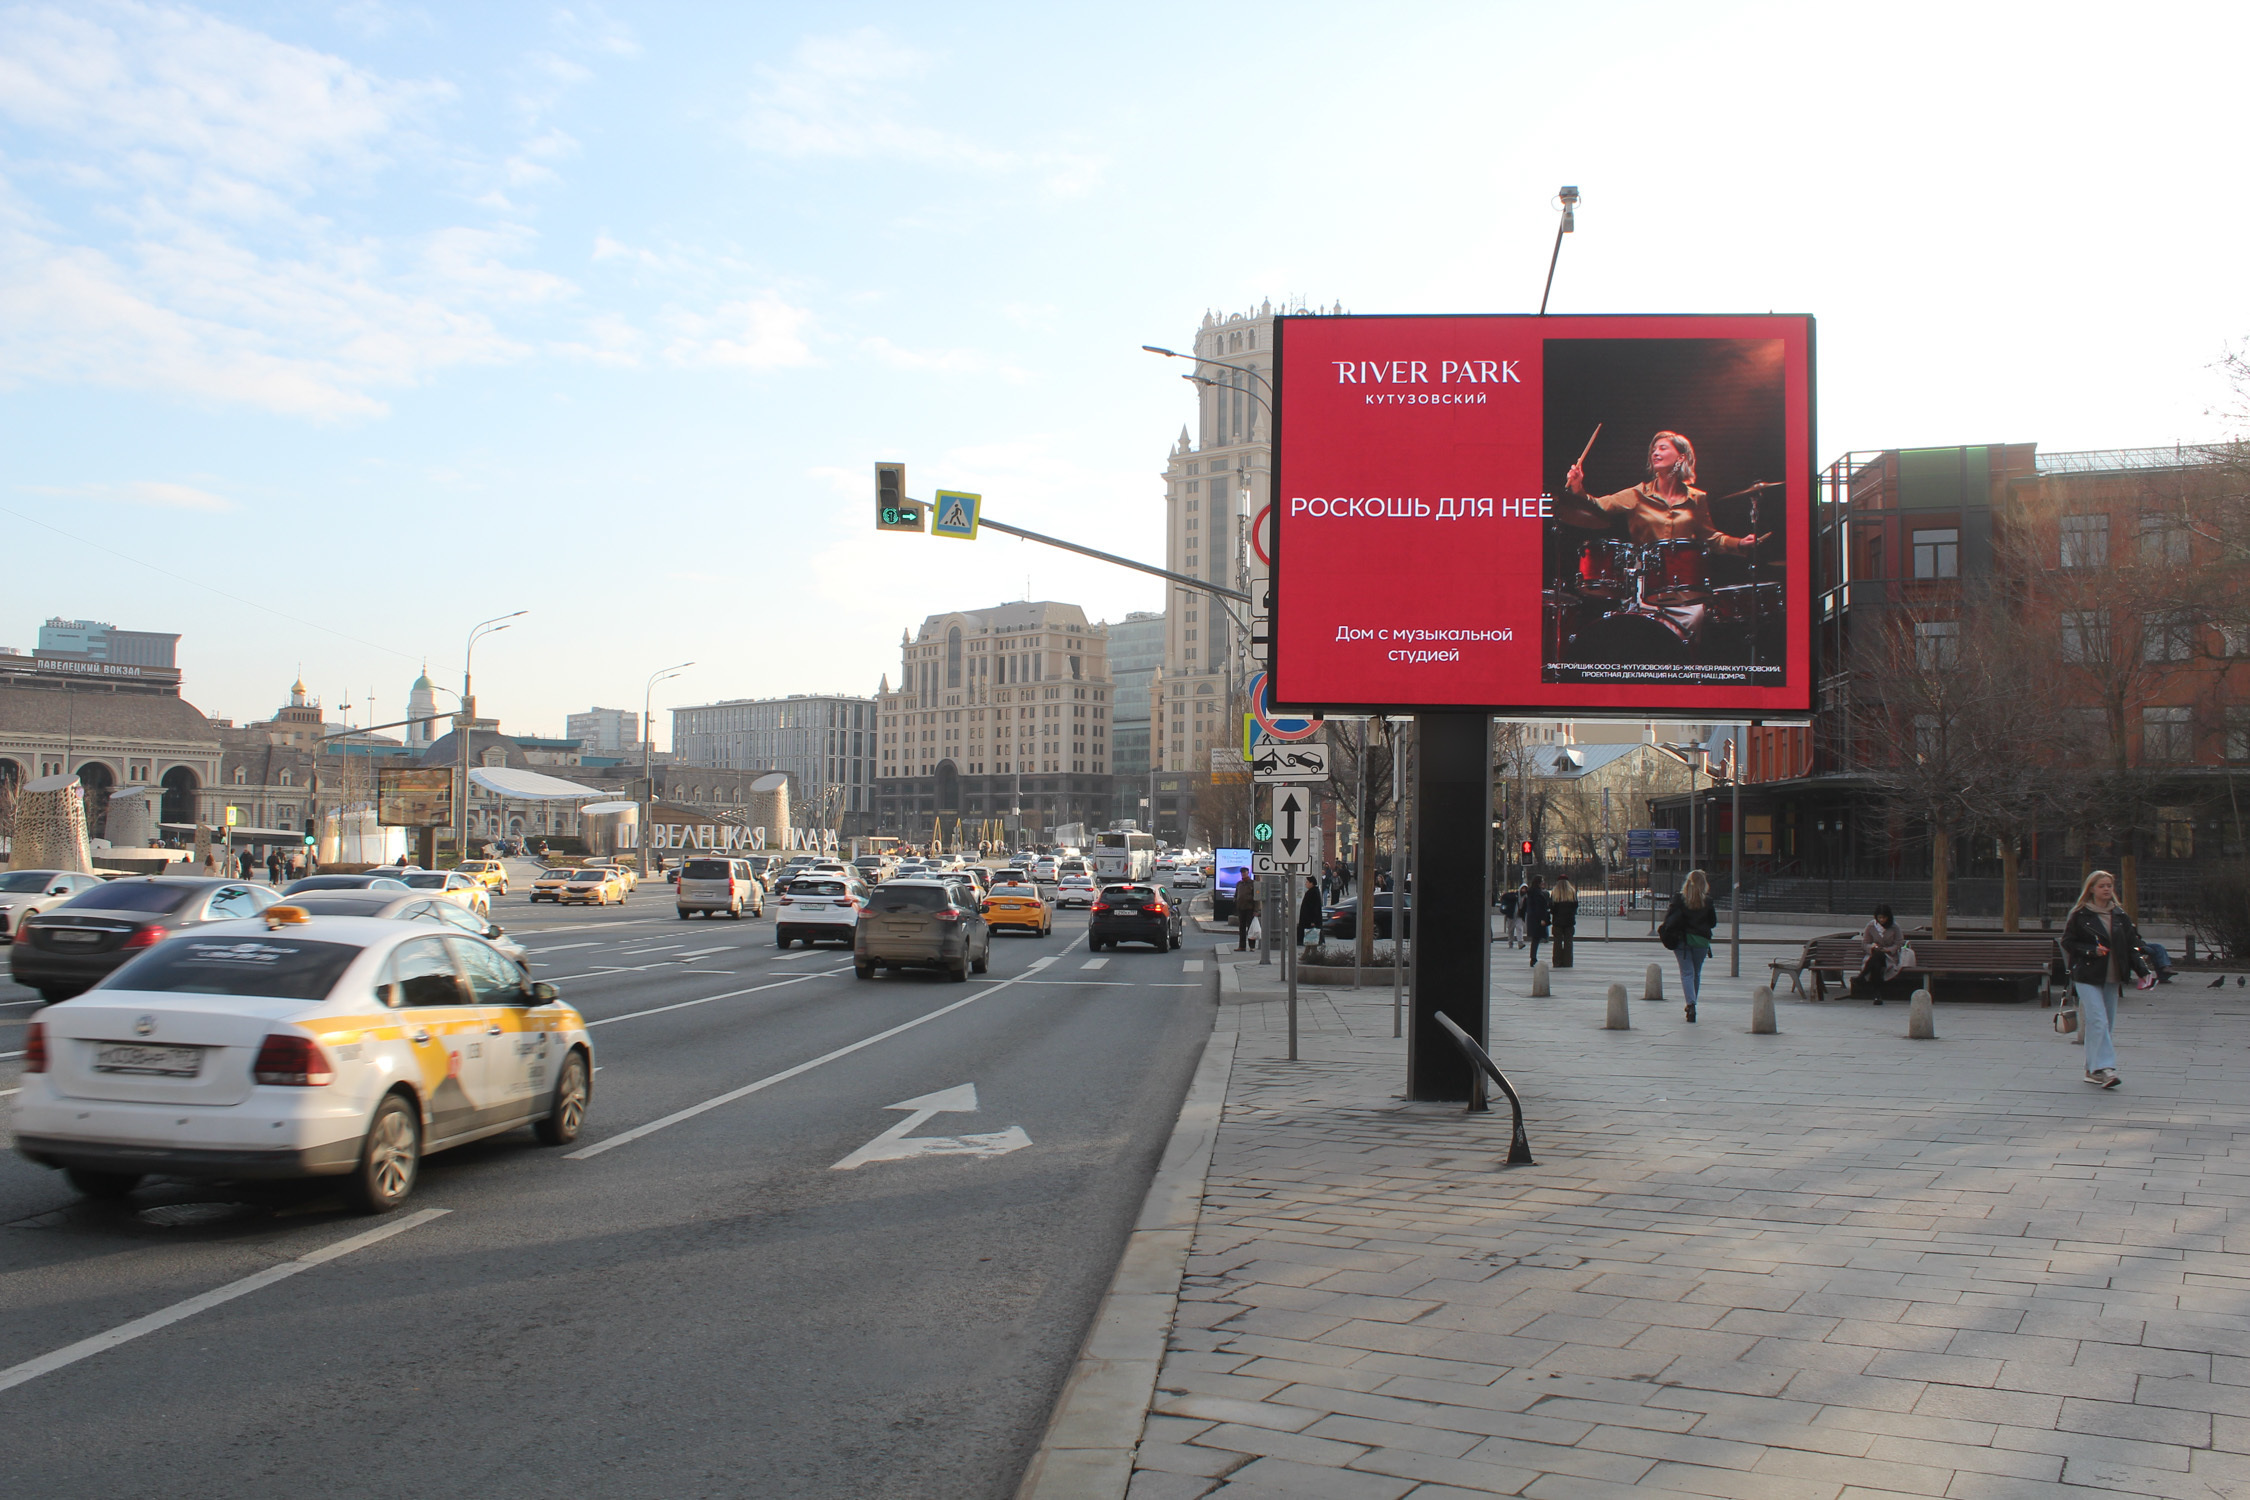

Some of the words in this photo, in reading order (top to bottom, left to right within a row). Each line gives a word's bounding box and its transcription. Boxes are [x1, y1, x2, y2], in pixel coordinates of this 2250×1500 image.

[1332, 361, 1428, 384] RIVER
[1442, 360, 1521, 384] PARK
[1365, 391, 1487, 405] КУТУЗОВСКИЙ
[1291, 497, 1431, 518] РОСКОШЬ
[1435, 497, 1494, 521] ДЛЯ
[1502, 492, 1554, 518] НЕЁ
[1335, 625, 1374, 643] Дом
[1378, 630, 1389, 640] с
[1393, 627, 1513, 643] музыкальной
[1388, 647, 1460, 664] студией
[37, 659, 100, 673] ПАВЕЛЕЦКИЙ
[104, 665, 140, 676] ВОКЗАЛ
[1546, 662, 1594, 670] ЗАСТРОЙЩИК
[1622, 671, 1668, 679] ДЕКЛАРАЦИЯ
[617, 824, 765, 855] ПВЕЛЕЦКАЯ
